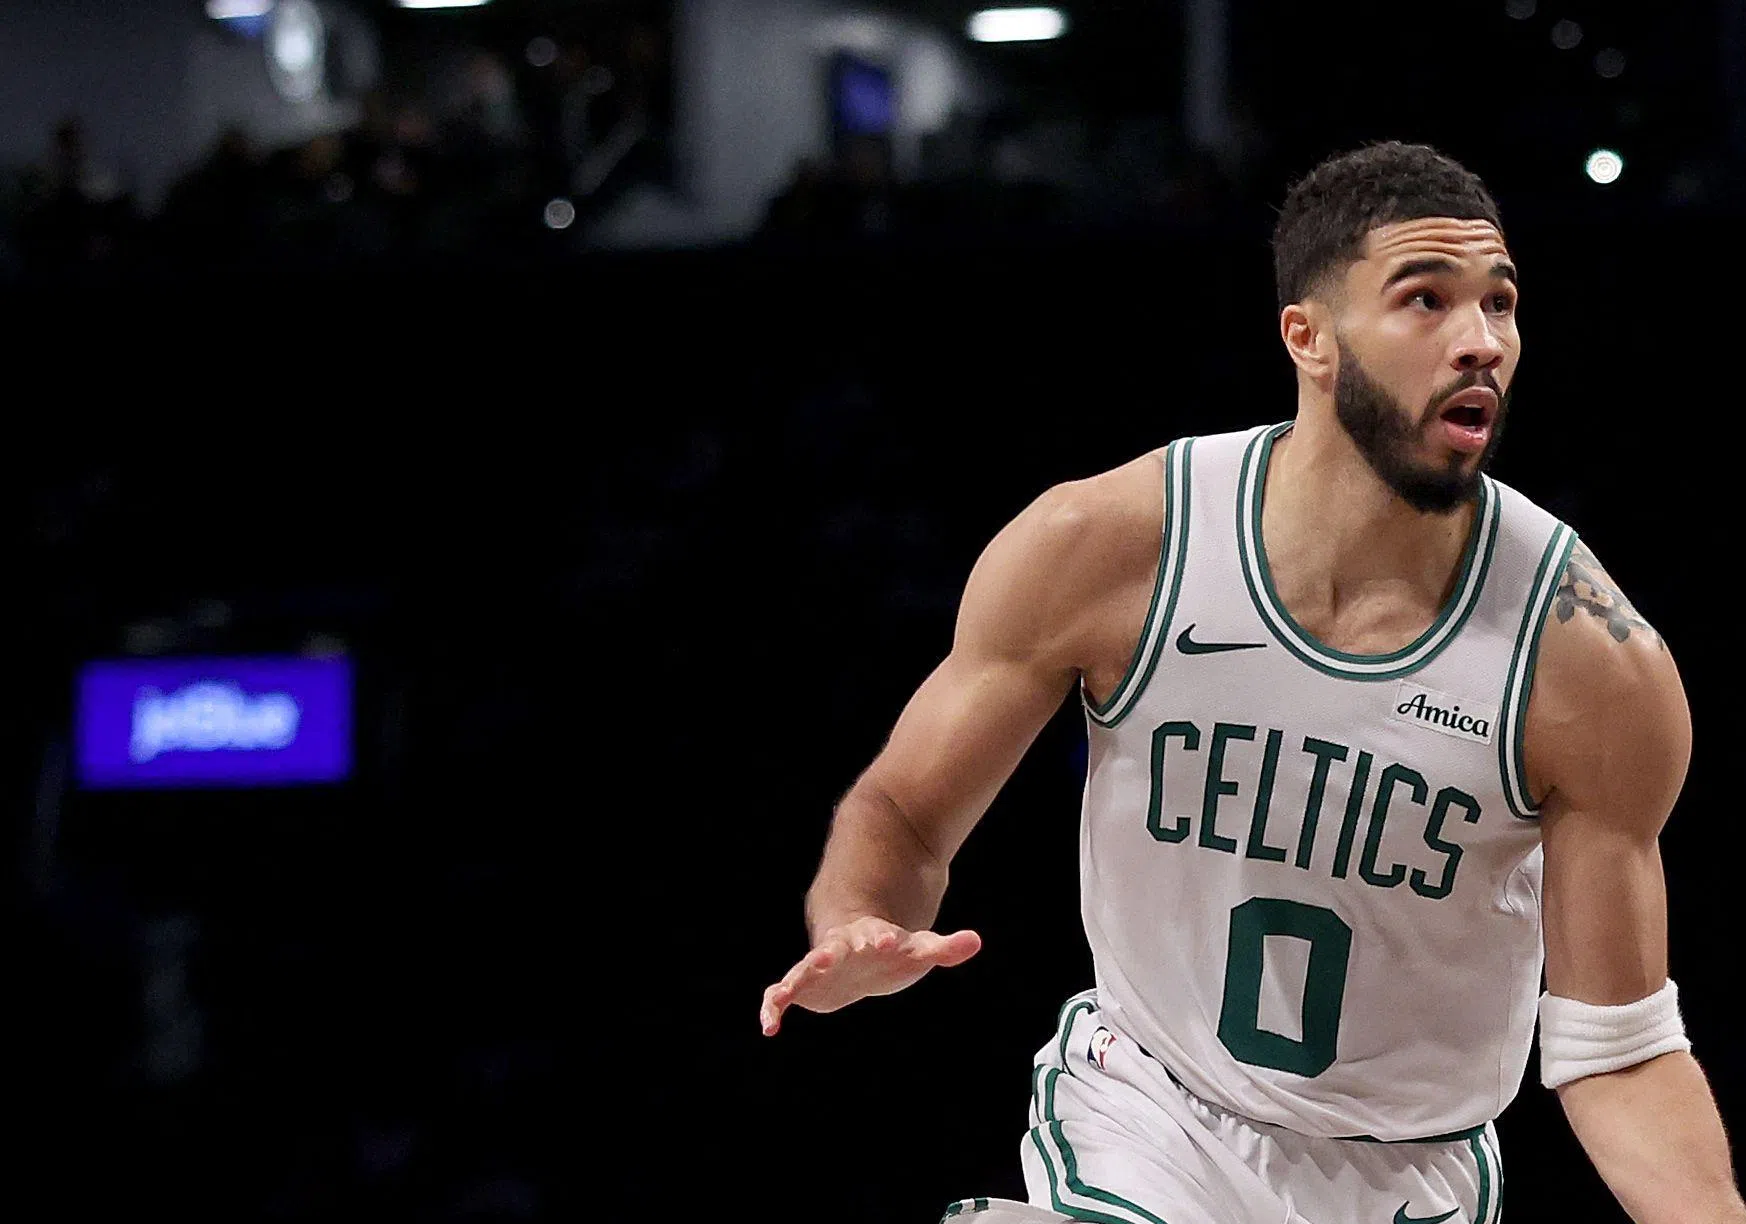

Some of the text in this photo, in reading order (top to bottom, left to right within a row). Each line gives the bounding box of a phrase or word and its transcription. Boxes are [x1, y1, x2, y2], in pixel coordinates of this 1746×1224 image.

[1396, 693, 1490, 738] Amica
[1145, 721, 1482, 900] CELTICS
[1216, 896, 1353, 1078] 0
